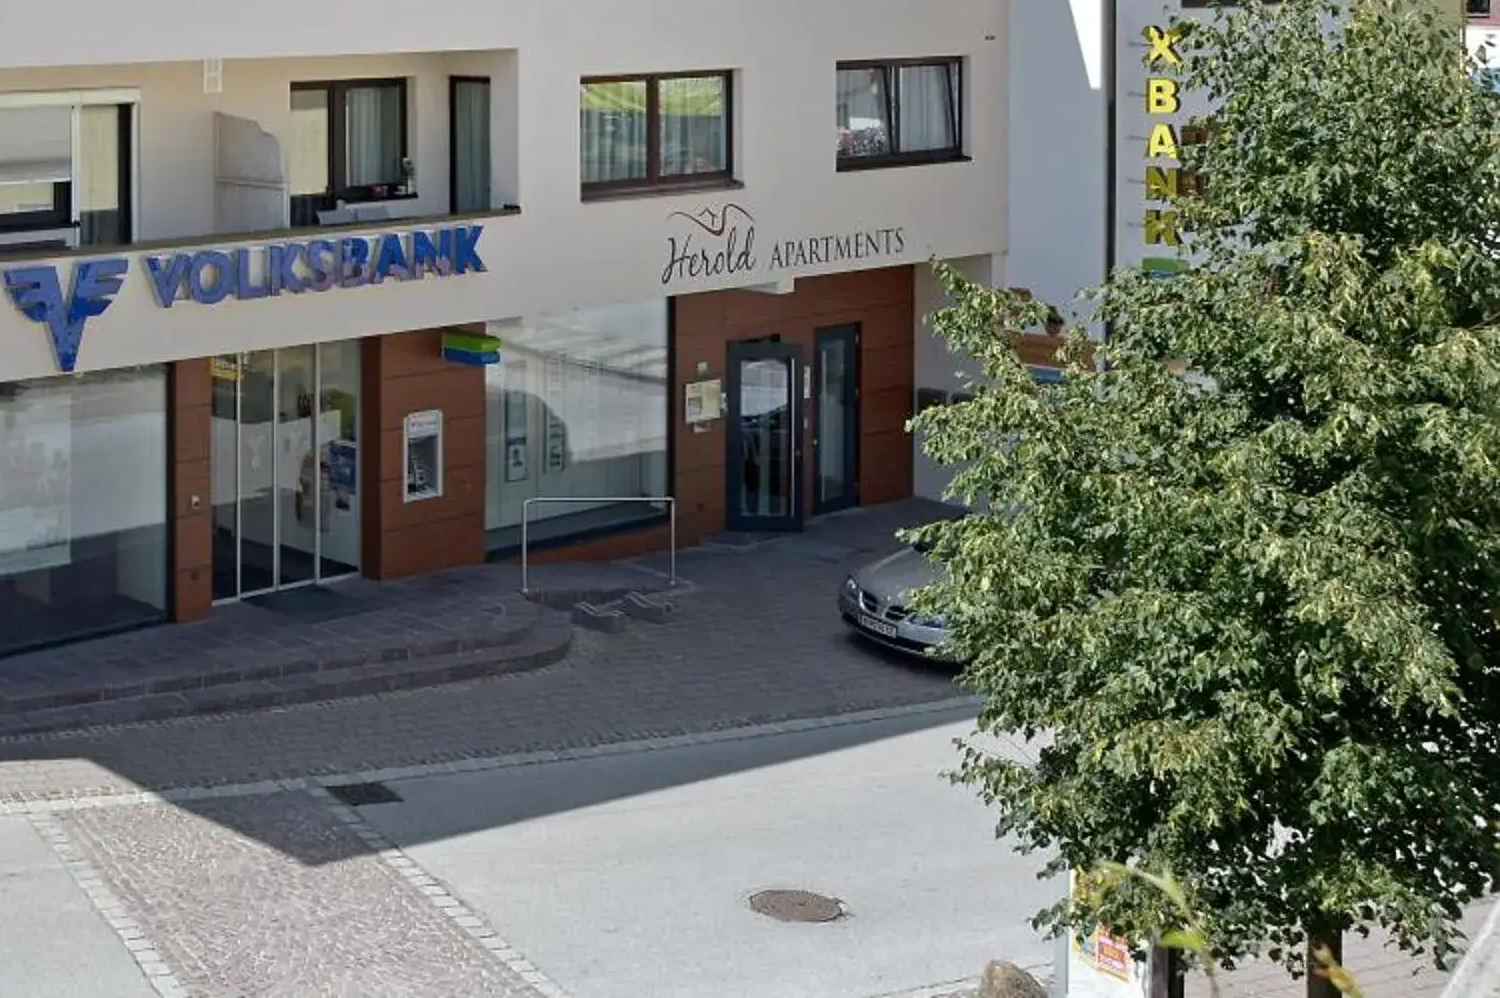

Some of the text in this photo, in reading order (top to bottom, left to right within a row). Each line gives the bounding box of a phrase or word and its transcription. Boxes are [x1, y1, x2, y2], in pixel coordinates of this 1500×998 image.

[145, 225, 488, 309] VOLKSBANK
[661, 225, 908, 285] Herold APARTMENTS
